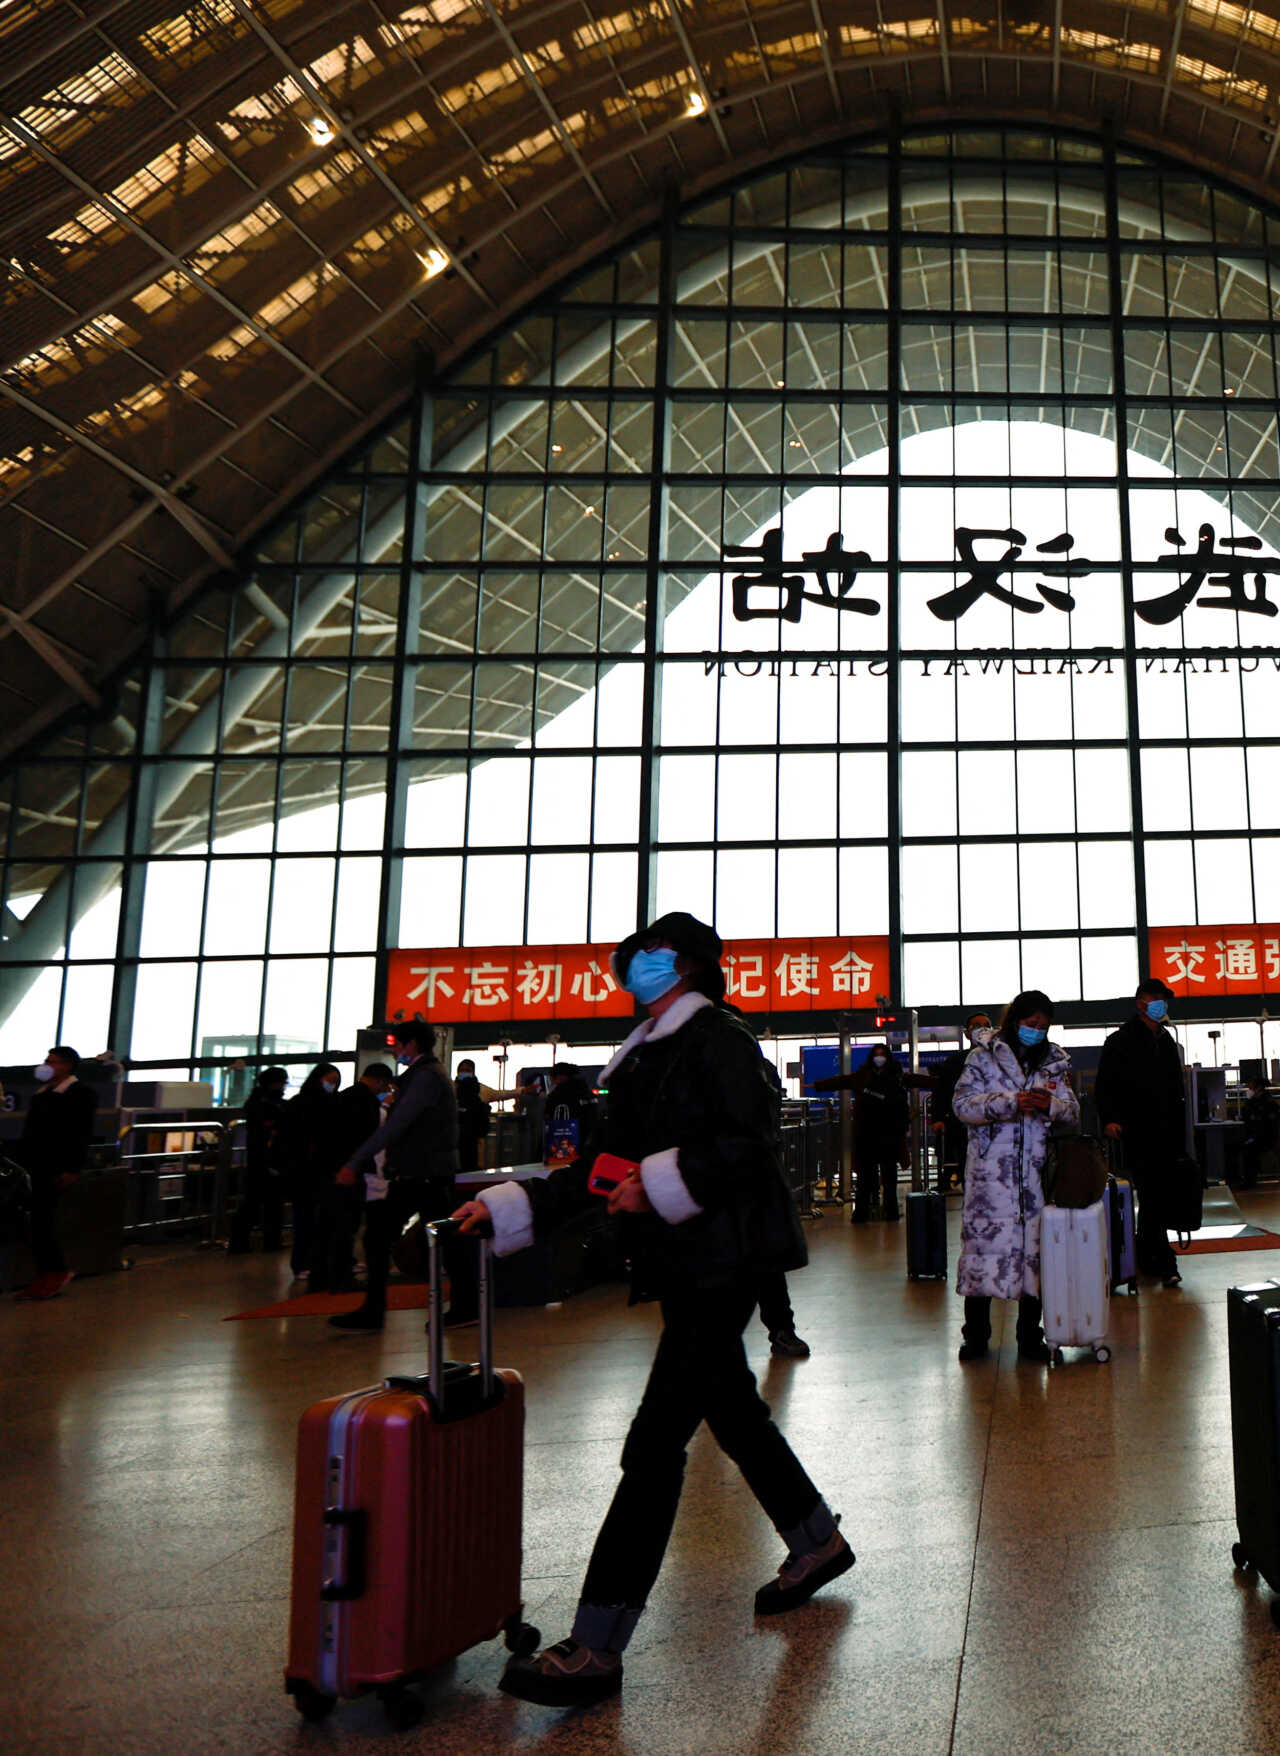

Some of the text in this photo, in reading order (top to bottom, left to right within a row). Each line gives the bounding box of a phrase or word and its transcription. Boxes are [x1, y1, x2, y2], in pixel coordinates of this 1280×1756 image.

[406, 951, 874, 1008] 不忘初心 记使命
